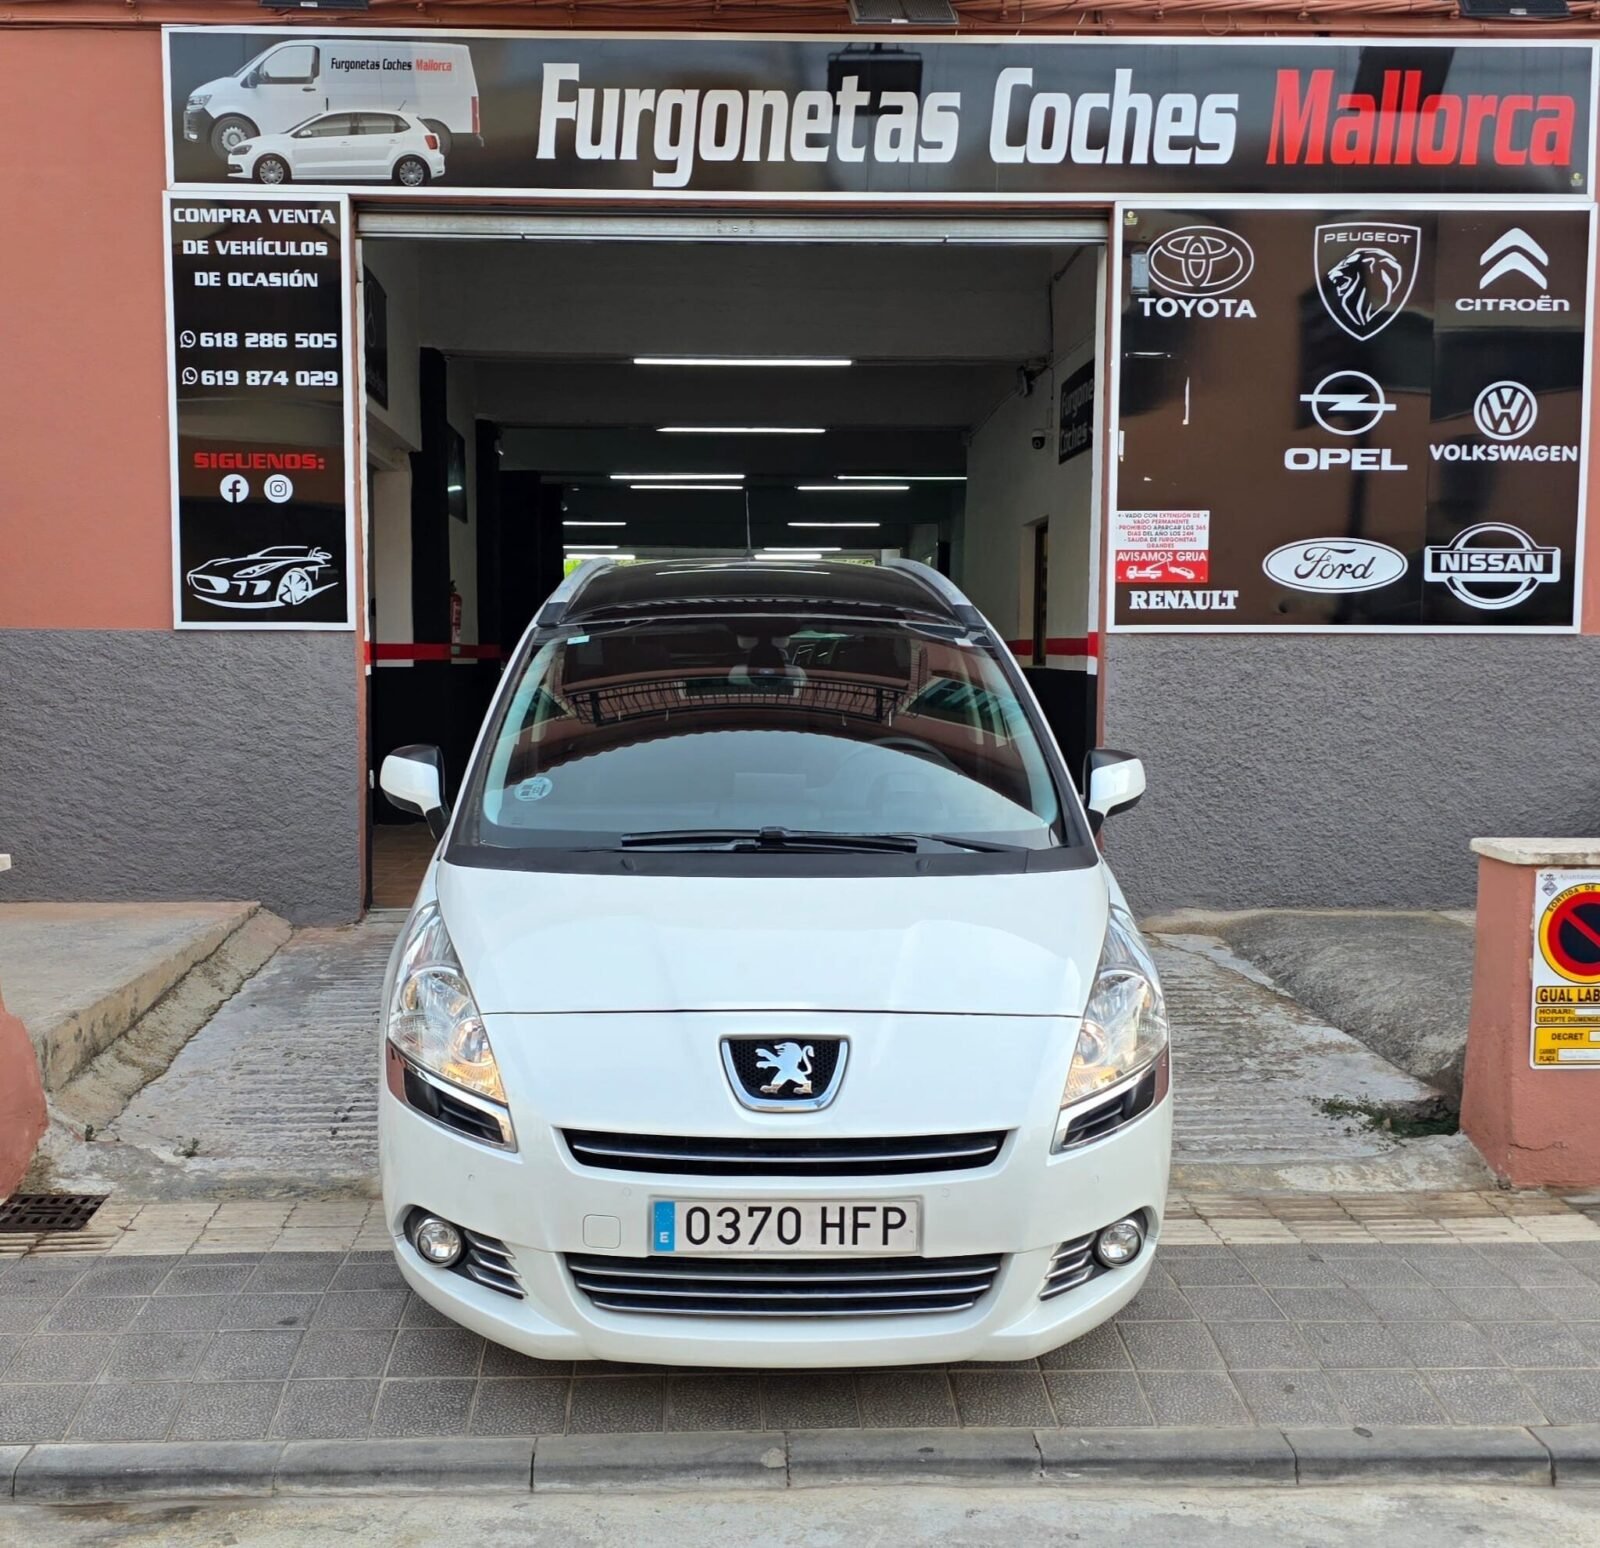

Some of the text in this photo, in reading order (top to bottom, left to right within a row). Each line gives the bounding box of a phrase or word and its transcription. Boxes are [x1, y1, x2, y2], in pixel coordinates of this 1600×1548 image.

[331, 58, 452, 72] Furgonetas Coches Mallorca
[535, 62, 1576, 188] Furgonetas Coches Mallorca
[173, 207, 336, 224] COMPRA VENTA
[182, 237, 328, 256] DE VEHÍCULOS
[1323, 231, 1413, 244] PEUGEOT
[194, 269, 319, 287] DE OCASIÓN
[1138, 298, 1257, 318] TOYOTA
[200, 332, 338, 348] 618 286 505
[201, 370, 338, 387] 619 874 029
[193, 452, 326, 470] SIGUENOS:
[1284, 447, 1408, 471] OPEL
[1429, 444, 1578, 462] VOLKSWAGEN
[1116, 552, 1207, 562] AVISAMOS GRUA
[1294, 546, 1376, 580] Ford
[1440, 553, 1544, 572] NISSAN
[1129, 590, 1239, 610] RENAULT
[1547, 887, 1579, 912] SORTIDA
[1540, 988, 1573, 1002] GUAL
[1551, 1032, 1584, 1040] DECRET
[659, 1206, 907, 1246] E 0370 HFP
